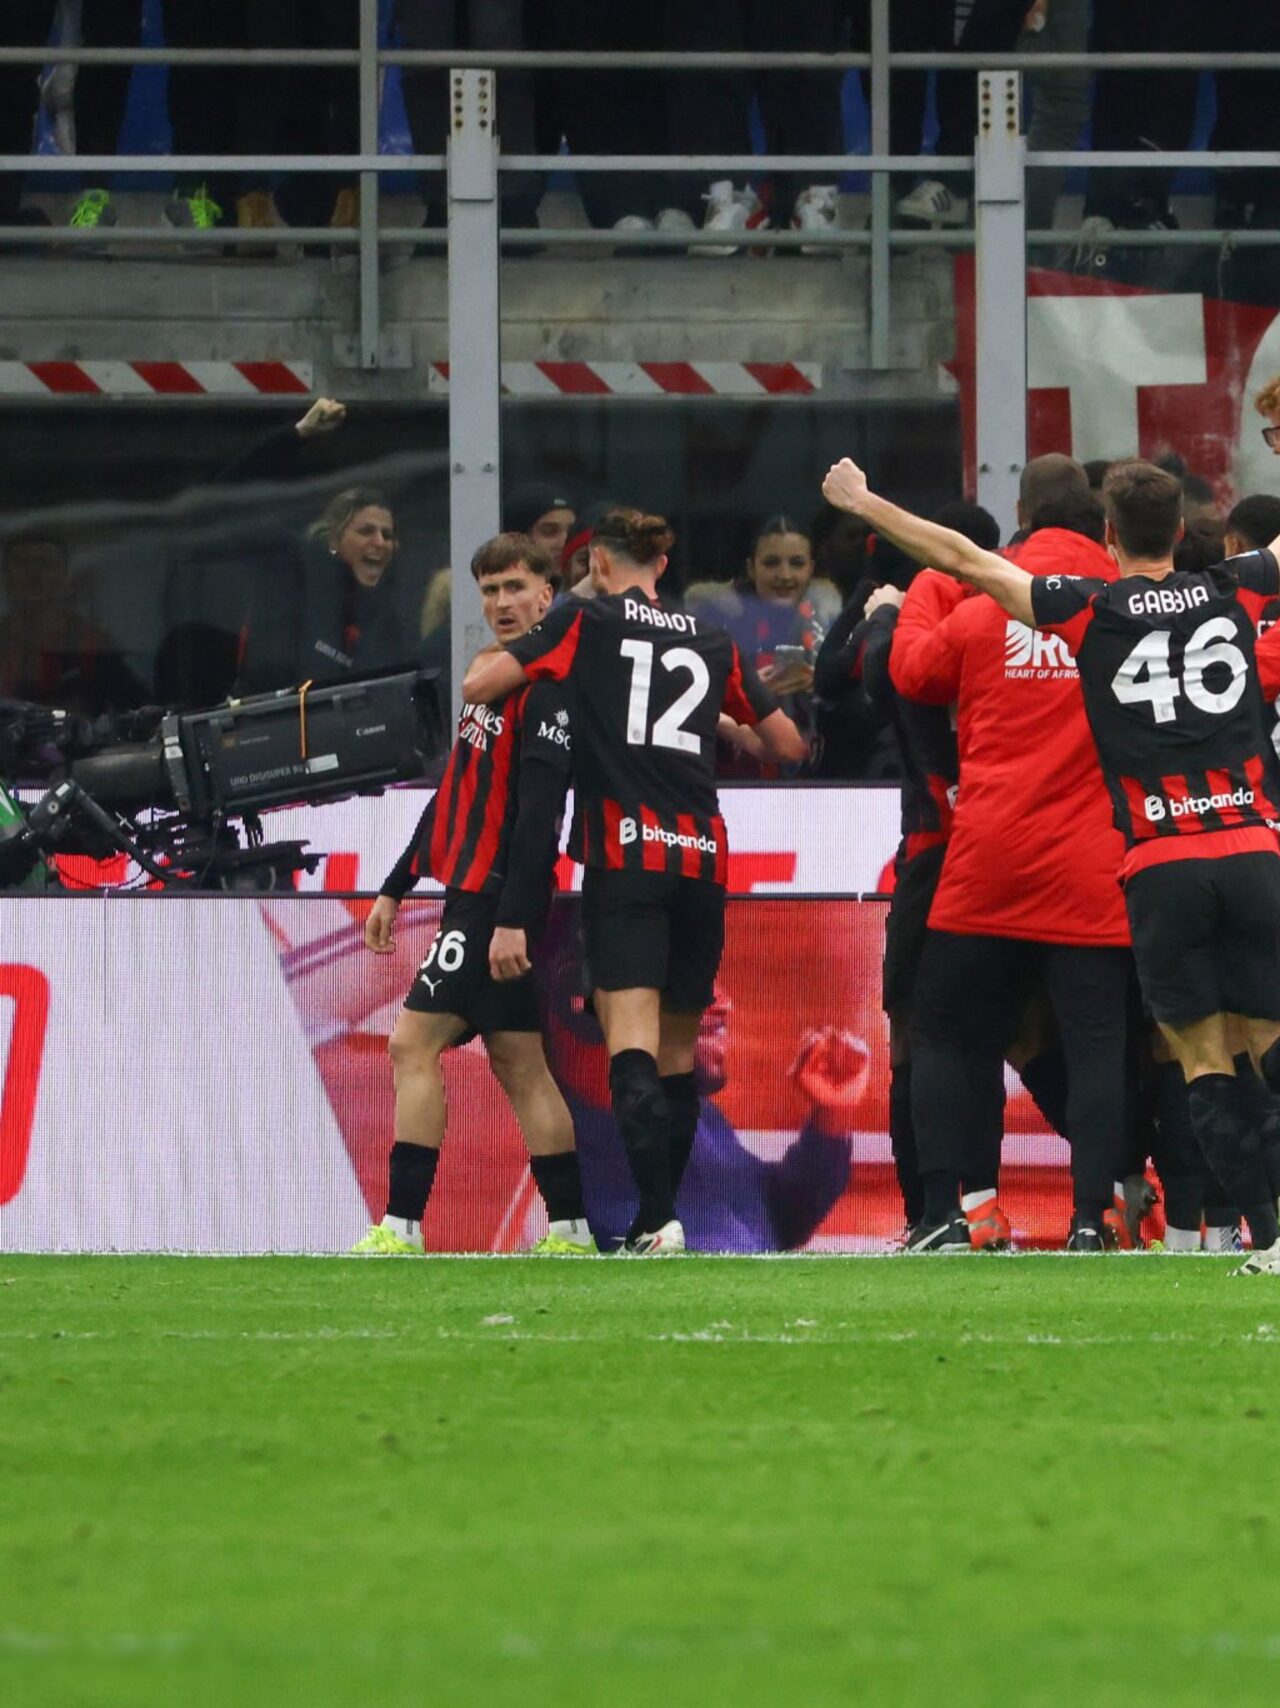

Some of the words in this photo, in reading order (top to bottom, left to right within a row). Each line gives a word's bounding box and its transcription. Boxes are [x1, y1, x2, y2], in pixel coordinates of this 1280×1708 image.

[1128, 586, 1209, 615] GABBIA
[624, 598, 697, 636] RABIOT
[1005, 669, 1035, 679] HEART
[1037, 669, 1050, 679] OF
[1052, 668, 1080, 679] AFRIC
[1111, 616, 1248, 723] 46
[620, 638, 710, 755] 12
[355, 724, 386, 737] Canon
[1170, 787, 1254, 817] bitpanda
[642, 823, 717, 853] bitpanda
